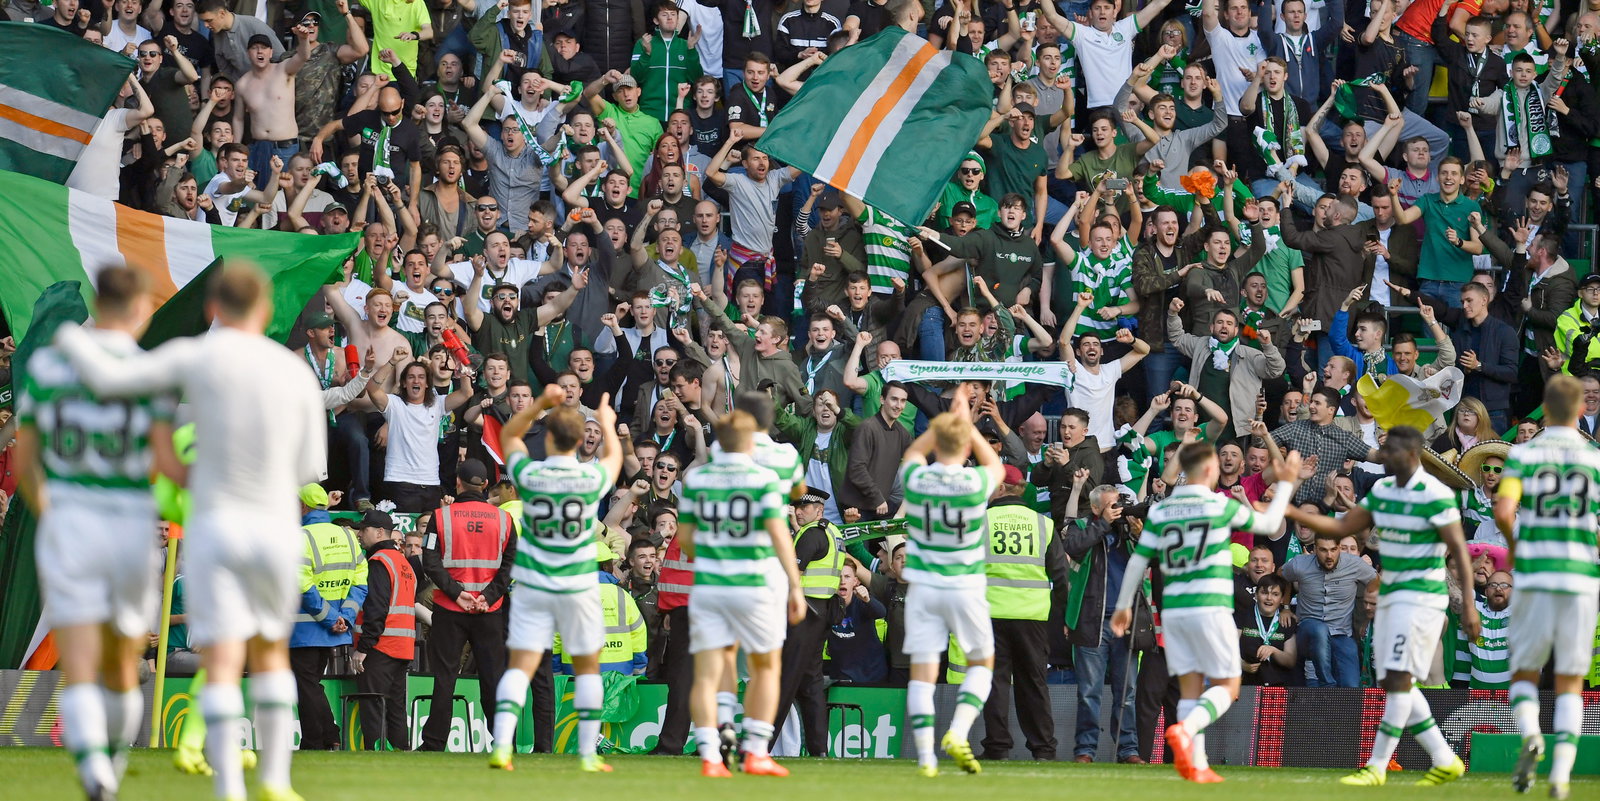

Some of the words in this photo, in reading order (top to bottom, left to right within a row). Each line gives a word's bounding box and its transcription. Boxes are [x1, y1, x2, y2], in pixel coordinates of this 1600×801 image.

[909, 364, 950, 377] Spirit
[1536, 469, 1590, 519] 23
[454, 510, 470, 519] PITCH
[470, 511, 497, 521] RESPONSE
[466, 521, 485, 533] 6E
[530, 498, 585, 540] 28
[699, 494, 751, 538] 49
[922, 500, 967, 543] 14
[993, 522, 1033, 531] STEWARD
[993, 530, 1034, 556] 331
[1162, 521, 1211, 569] 27
[1395, 633, 1407, 656] 2
